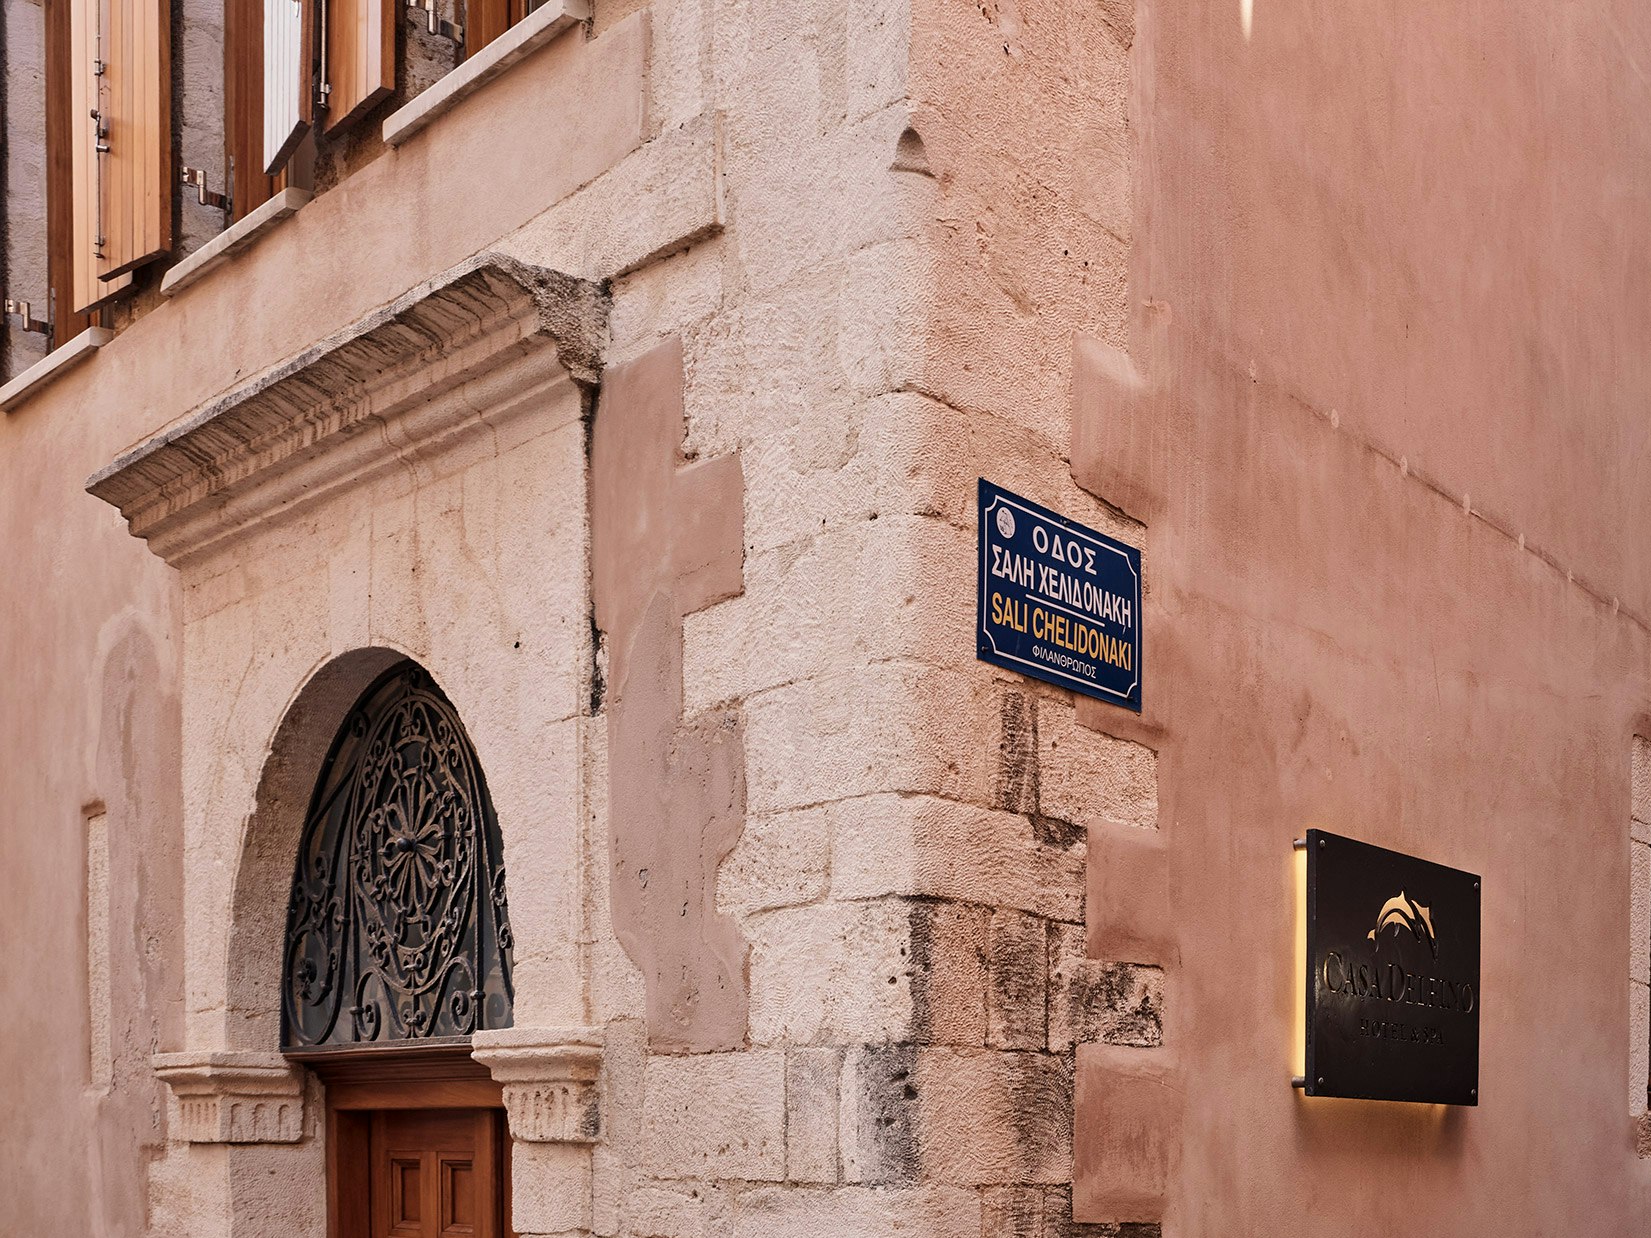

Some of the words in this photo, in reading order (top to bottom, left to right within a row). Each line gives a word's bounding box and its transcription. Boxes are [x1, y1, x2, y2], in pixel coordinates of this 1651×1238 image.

[1033, 525, 1097, 575] ΟΔΟΣ
[992, 544, 1034, 589] ΣΑΛΗ
[1038, 562, 1131, 628] ΧΕΛΙΔΟΝΑΚΗ
[992, 592, 1028, 634] SALI
[1032, 607, 1131, 671] CHELIDONAKI
[1032, 645, 1097, 679] ΦΙΛΑΝΘΡΩΠΟΣ
[1322, 951, 1384, 1000] CASA
[1387, 963, 1474, 1014] DELFINO
